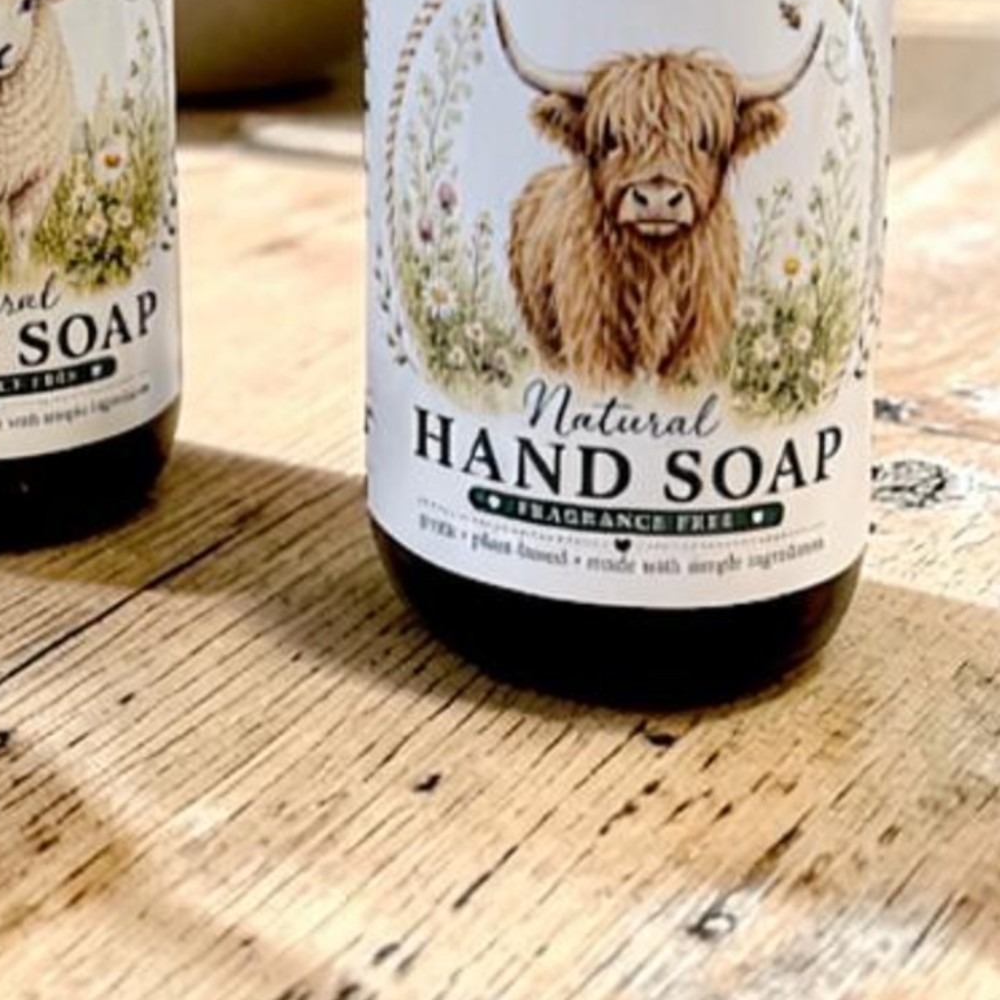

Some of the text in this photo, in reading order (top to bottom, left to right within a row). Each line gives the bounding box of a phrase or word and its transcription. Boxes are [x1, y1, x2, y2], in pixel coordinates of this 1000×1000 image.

[18, 290, 158, 367] SOAP
[522, 377, 722, 440] Natural
[413, 405, 843, 503] HAND SOAP
[516, 499, 735, 532] FRAGRANCE FREE
